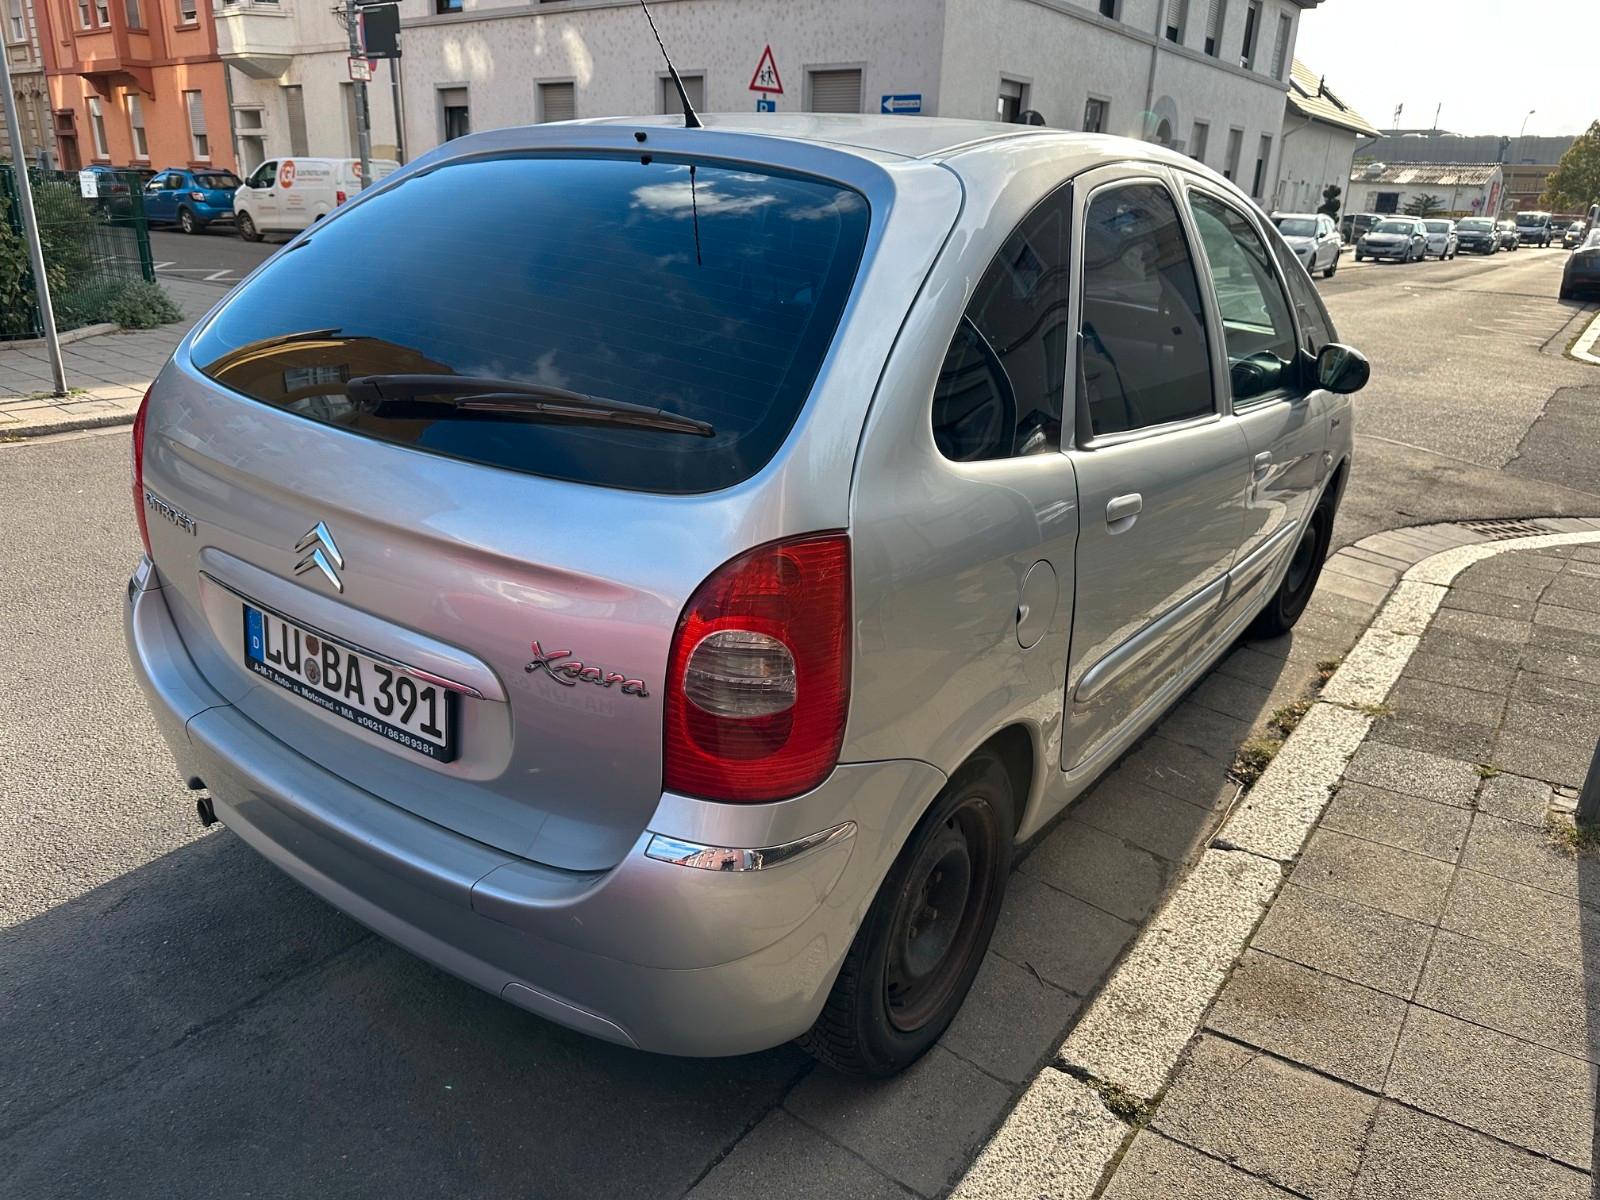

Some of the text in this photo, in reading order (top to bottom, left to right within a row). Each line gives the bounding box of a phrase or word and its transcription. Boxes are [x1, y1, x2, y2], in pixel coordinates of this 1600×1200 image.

[253, 636, 260, 649] D
[264, 614, 301, 675] LU
[321, 641, 365, 705] BA
[373, 664, 442, 739] 391
[301, 687, 335, 710] Motorrad
[341, 706, 354, 720] MA
